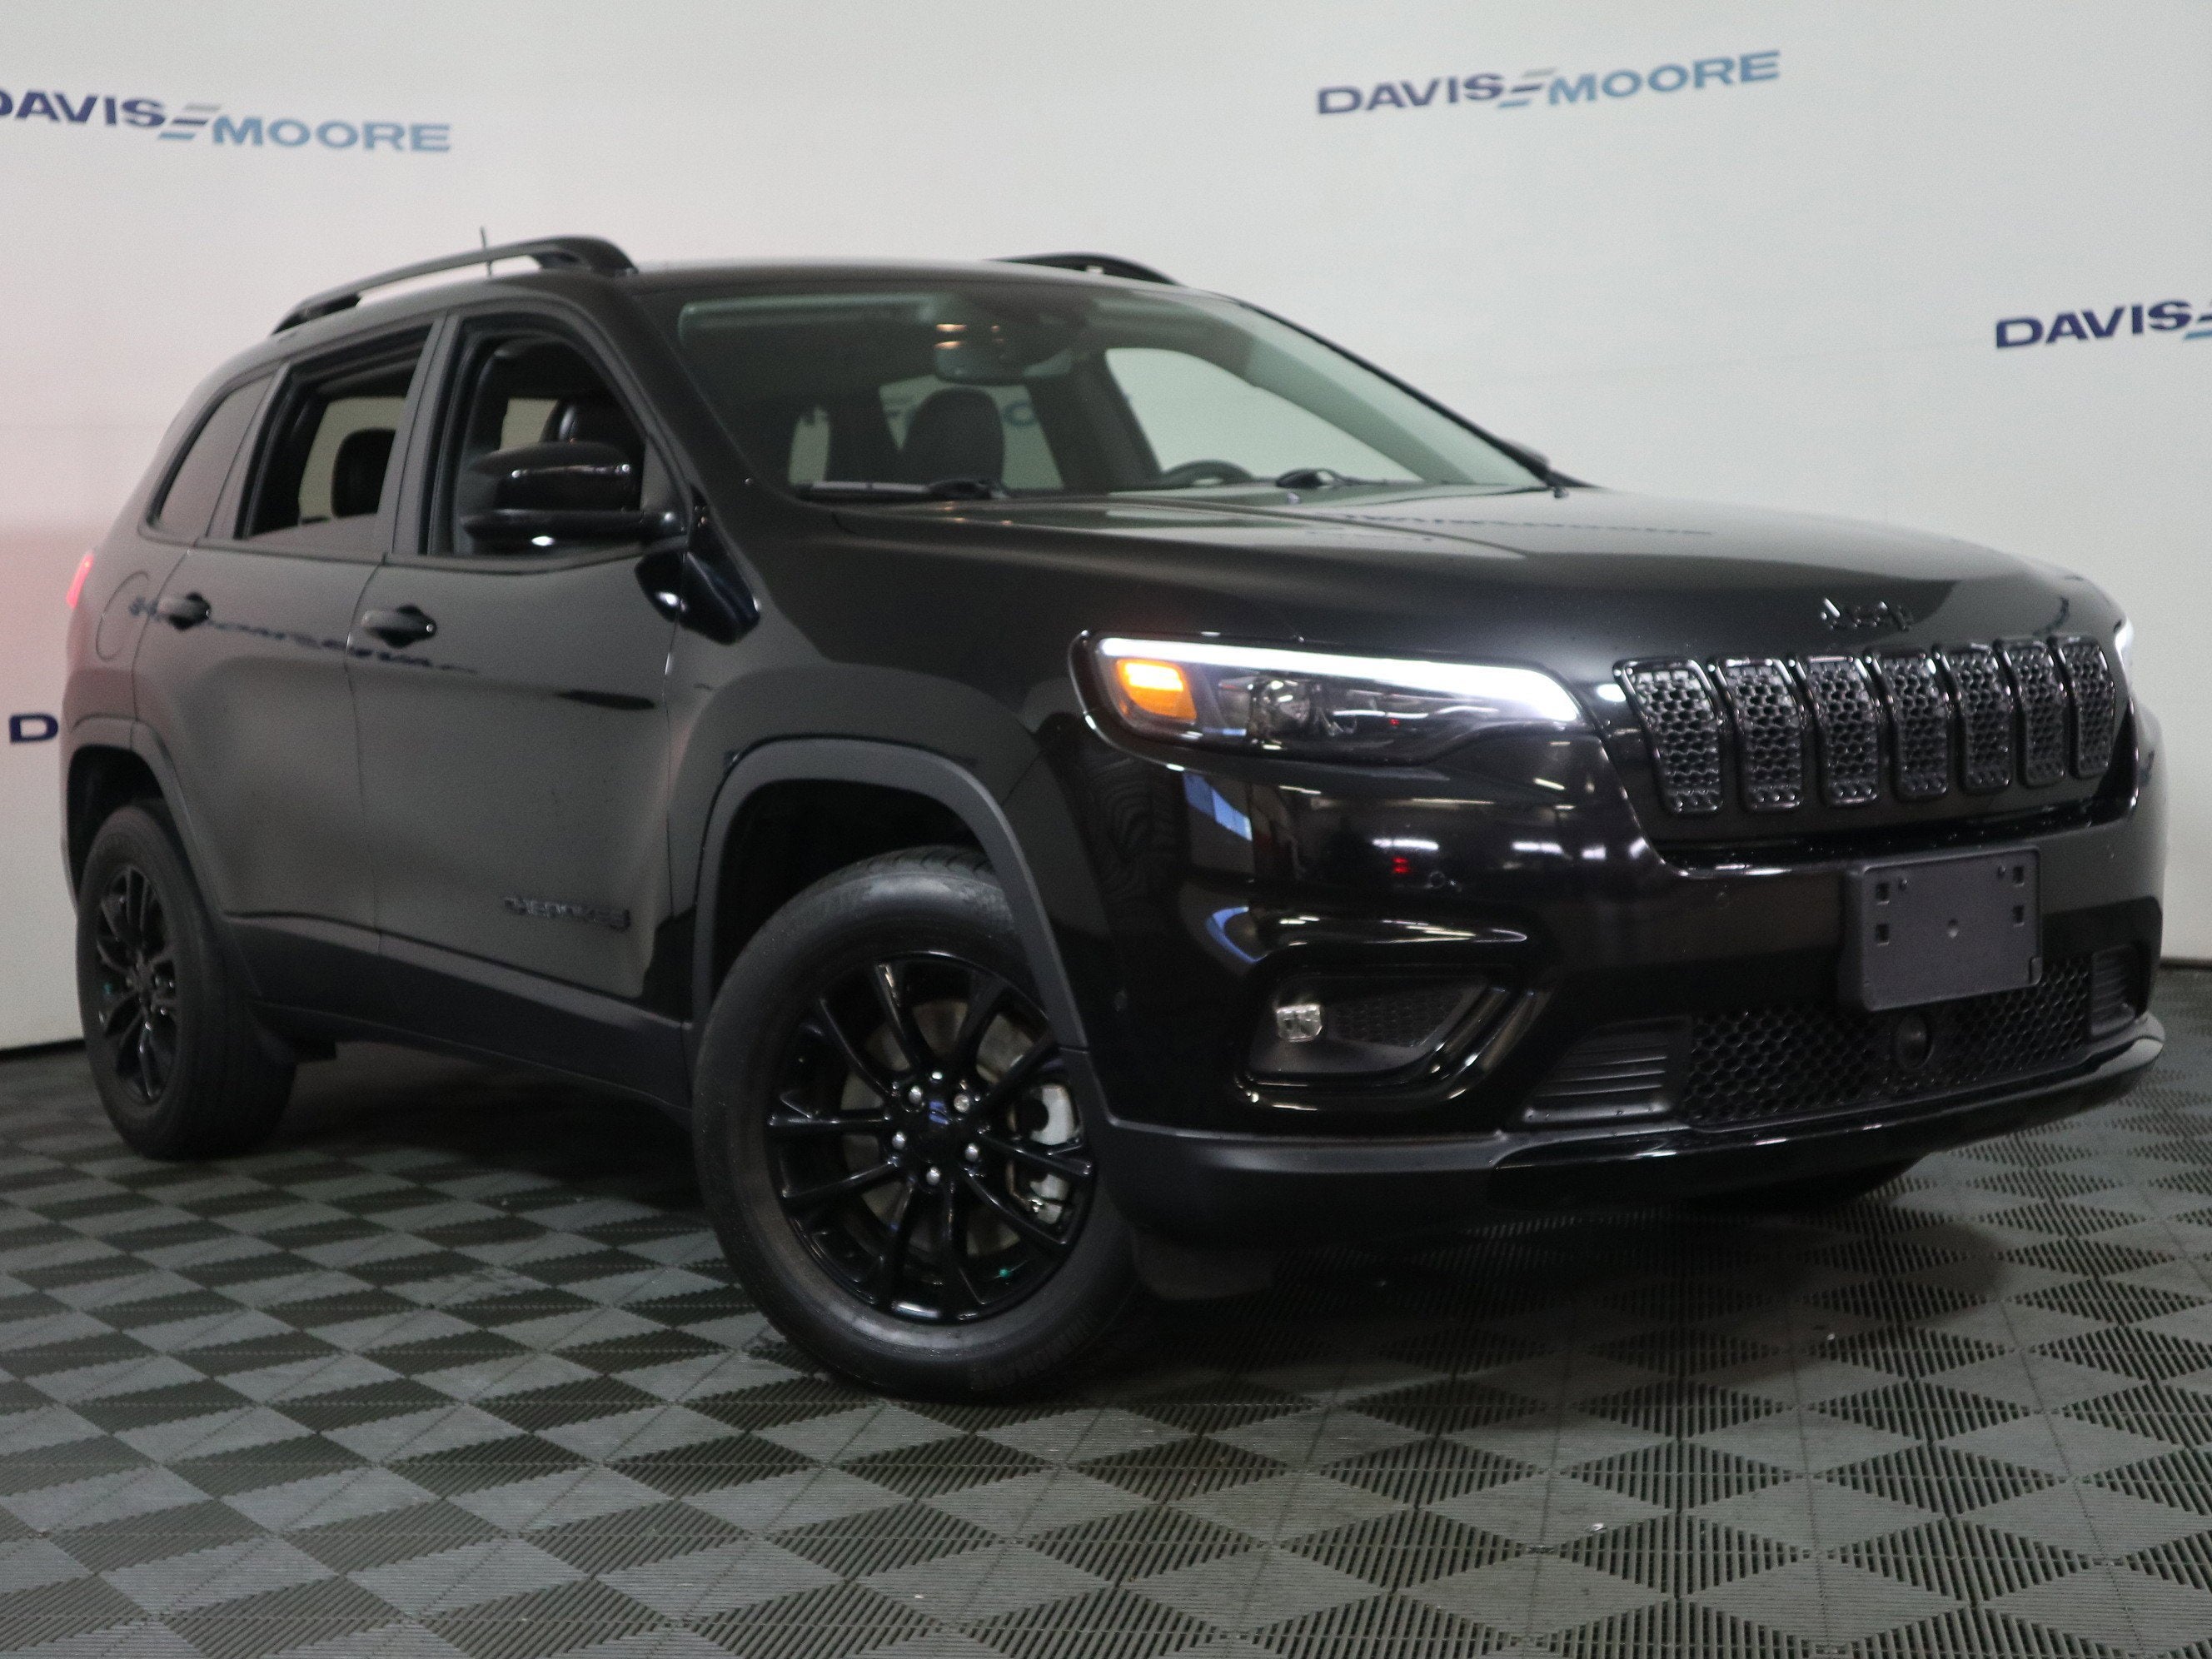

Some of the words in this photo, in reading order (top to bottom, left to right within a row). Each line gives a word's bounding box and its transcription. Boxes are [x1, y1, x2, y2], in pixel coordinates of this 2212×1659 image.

[1317, 73, 1502, 117] DAVIS
[1547, 49, 1781, 107] MOORE
[0, 89, 167, 129] AVIS
[212, 115, 451, 153] MOORE
[1995, 299, 2194, 351] DAVIS
